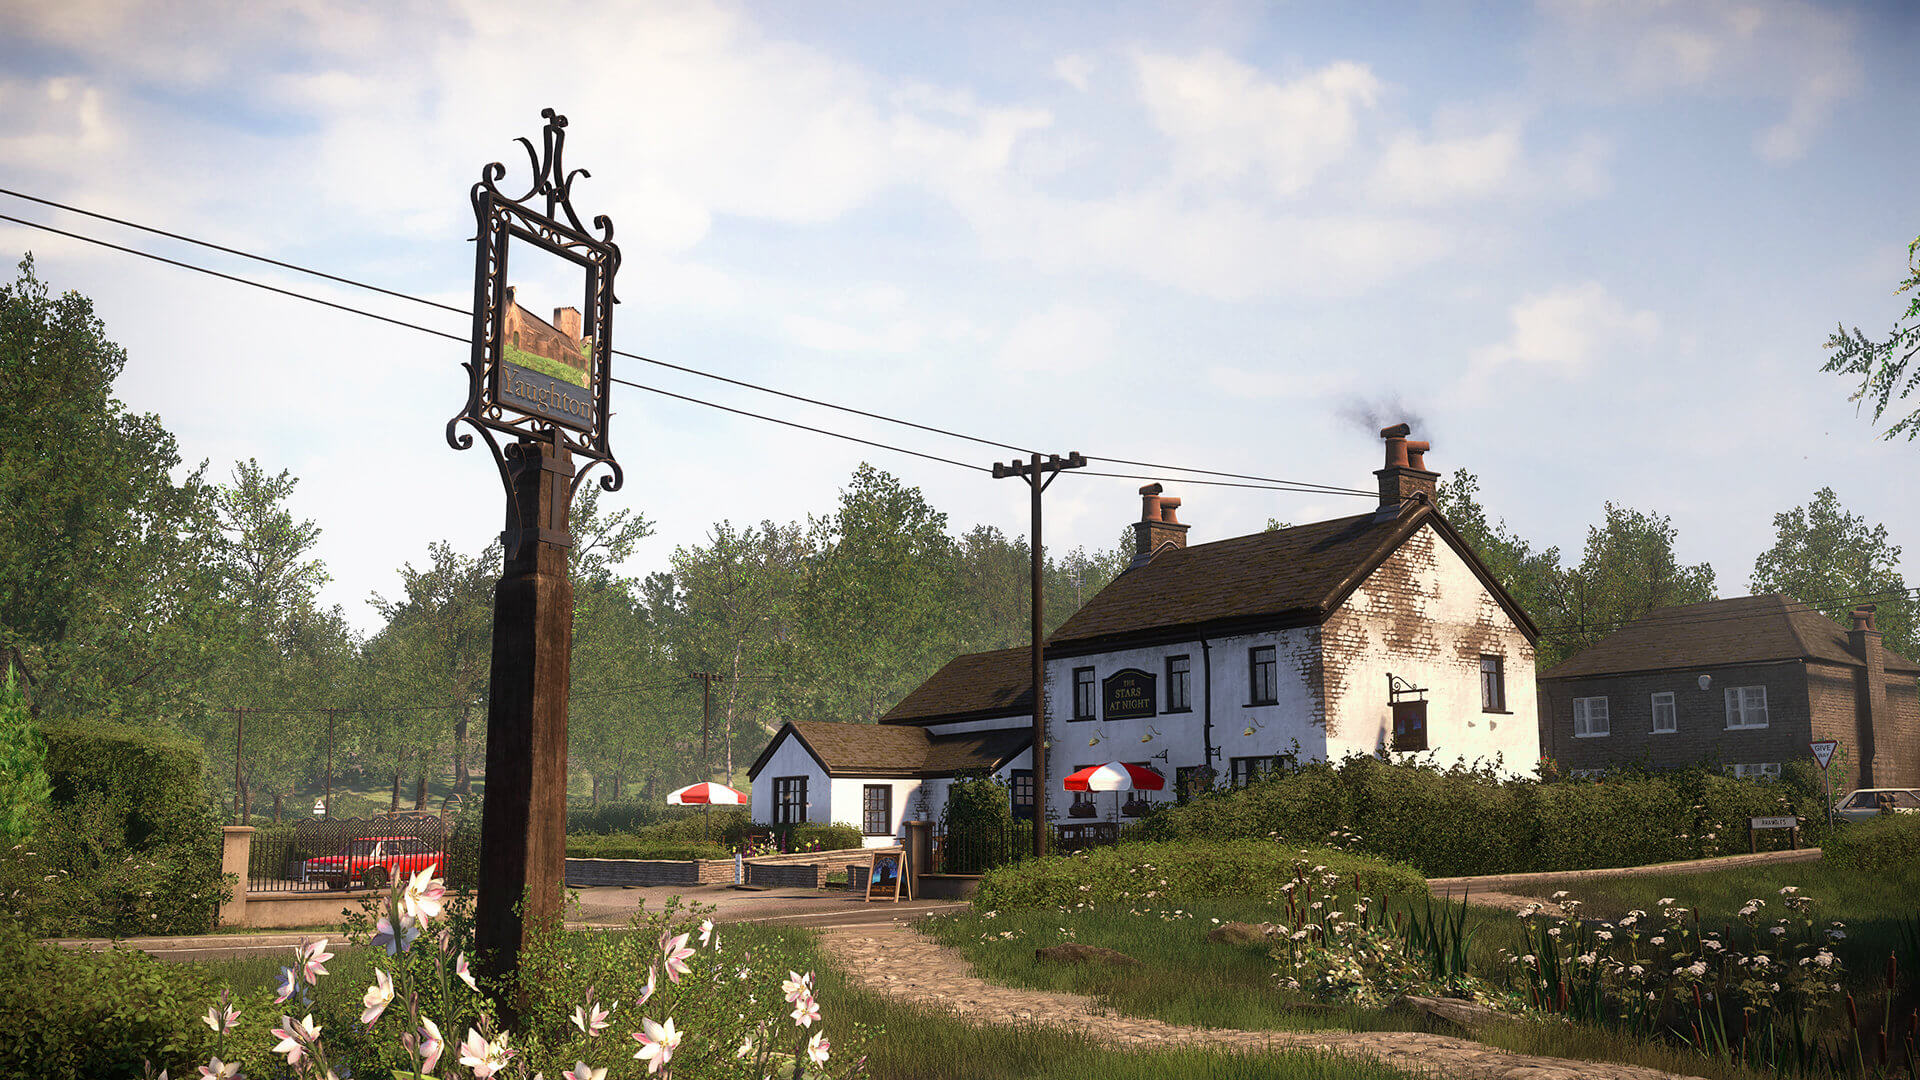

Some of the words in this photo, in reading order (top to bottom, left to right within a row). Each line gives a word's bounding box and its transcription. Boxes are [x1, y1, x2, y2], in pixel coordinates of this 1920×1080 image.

[502, 365, 592, 420] Yaughton
[1114, 687, 1141, 699] STARS
[1109, 701, 1121, 711] AT
[1122, 698, 1150, 710] NIGHT
[1814, 744, 1832, 752] GIVE
